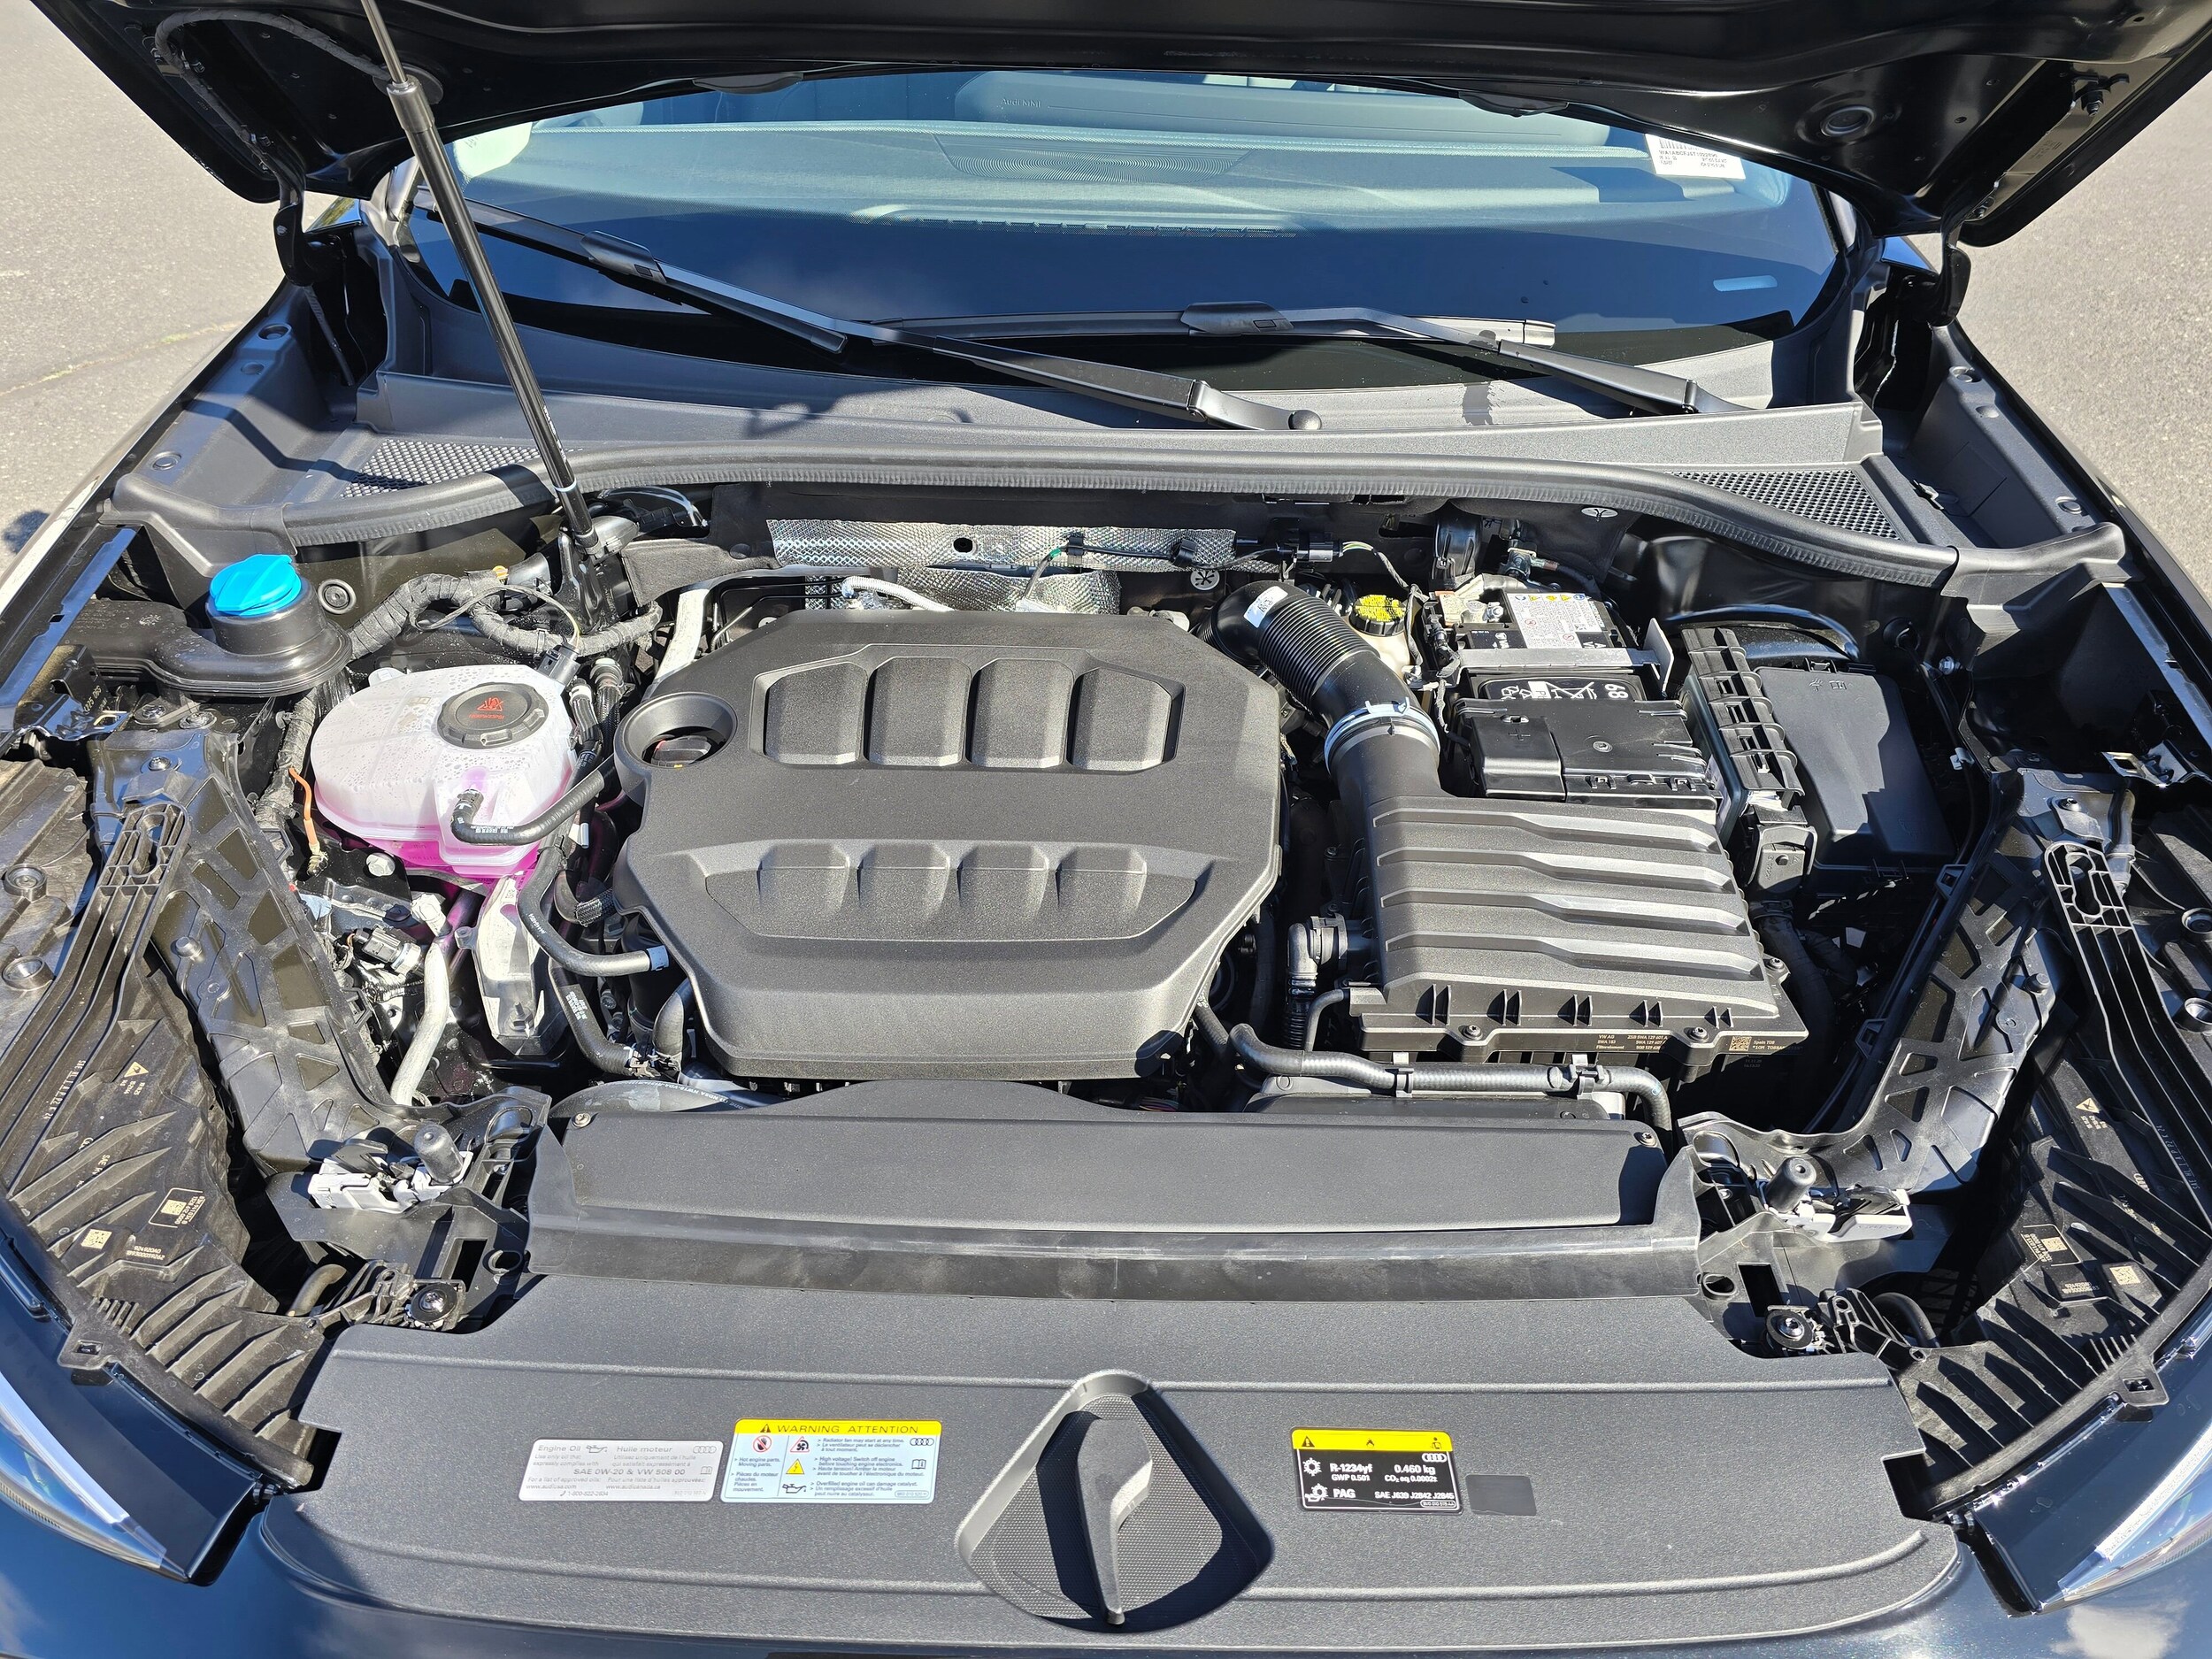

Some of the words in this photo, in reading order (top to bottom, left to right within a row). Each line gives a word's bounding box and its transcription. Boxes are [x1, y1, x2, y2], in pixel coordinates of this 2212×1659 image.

[1001, 97, 1020, 106] Audi
[1329, 1463, 1372, 1474] R-1234yf
[1394, 1464, 1421, 1473] 0.460
[1423, 1464, 1435, 1475] kg
[1333, 1488, 1356, 1498] PAG
